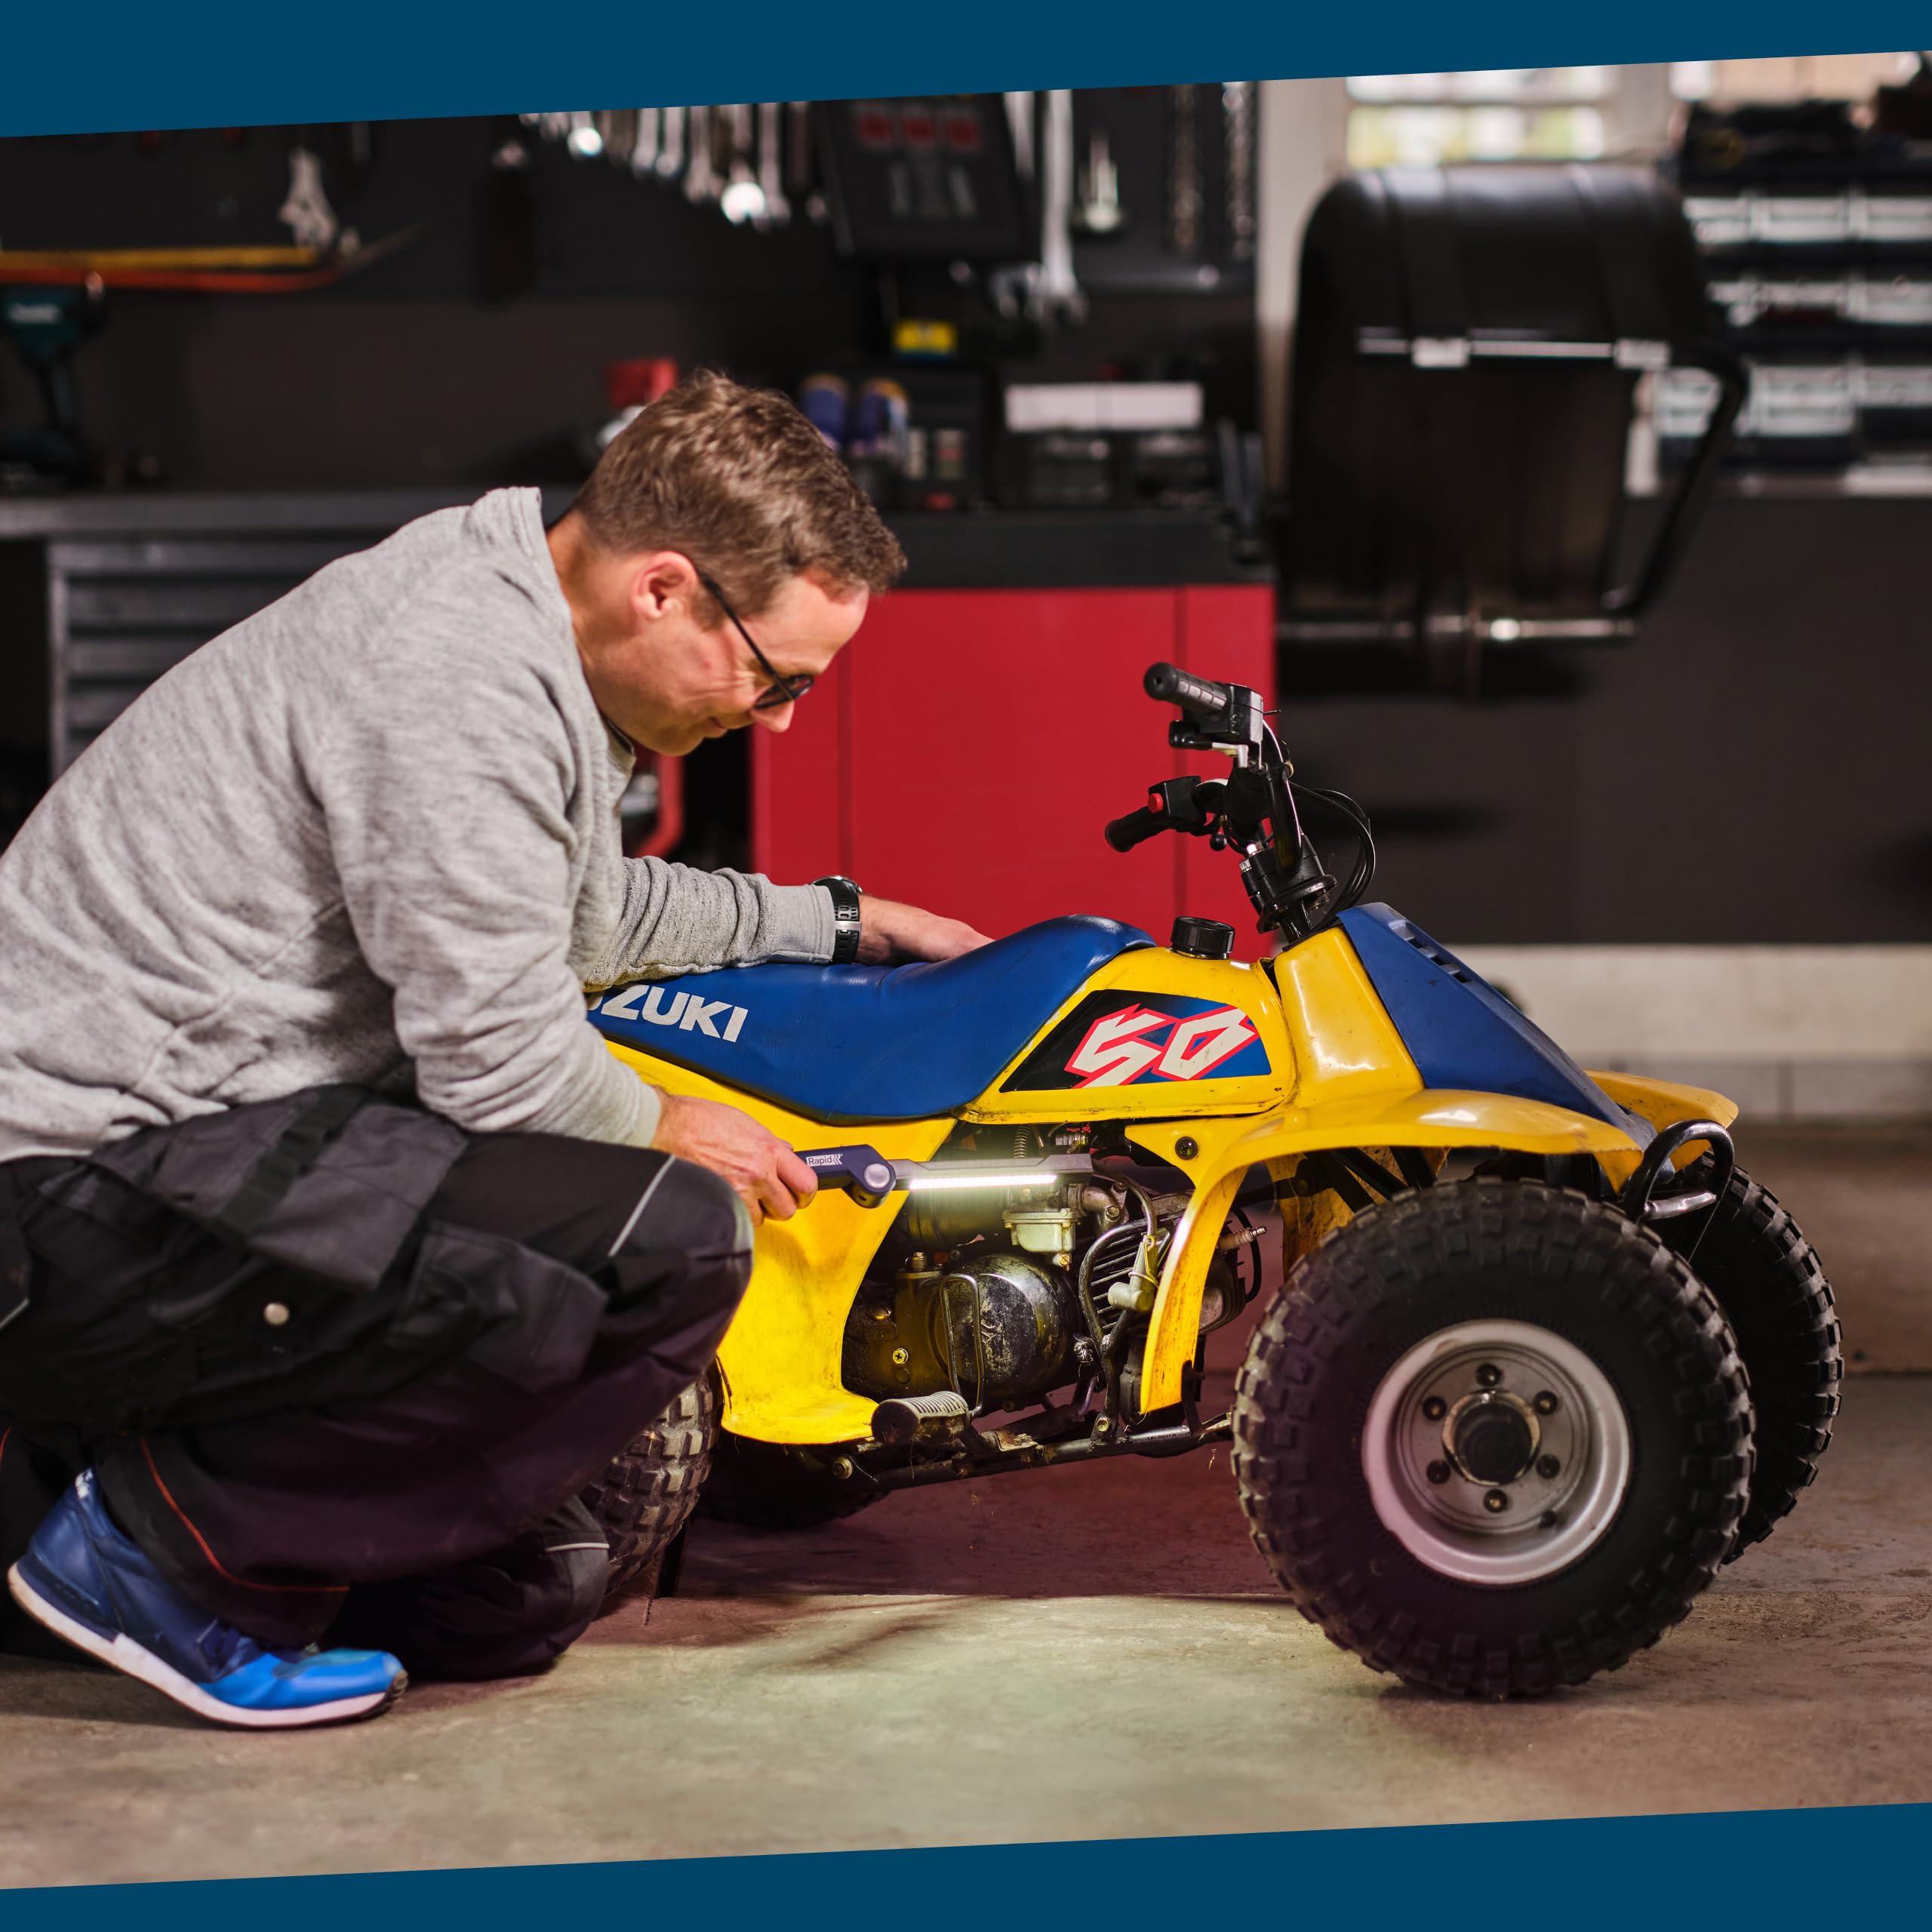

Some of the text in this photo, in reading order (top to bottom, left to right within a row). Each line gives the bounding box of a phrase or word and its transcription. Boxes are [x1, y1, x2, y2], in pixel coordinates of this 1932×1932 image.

[587, 984, 749, 1043] ZUKI
[1064, 1003, 1260, 1089] 50
[808, 1156, 832, 1166] Rapid
